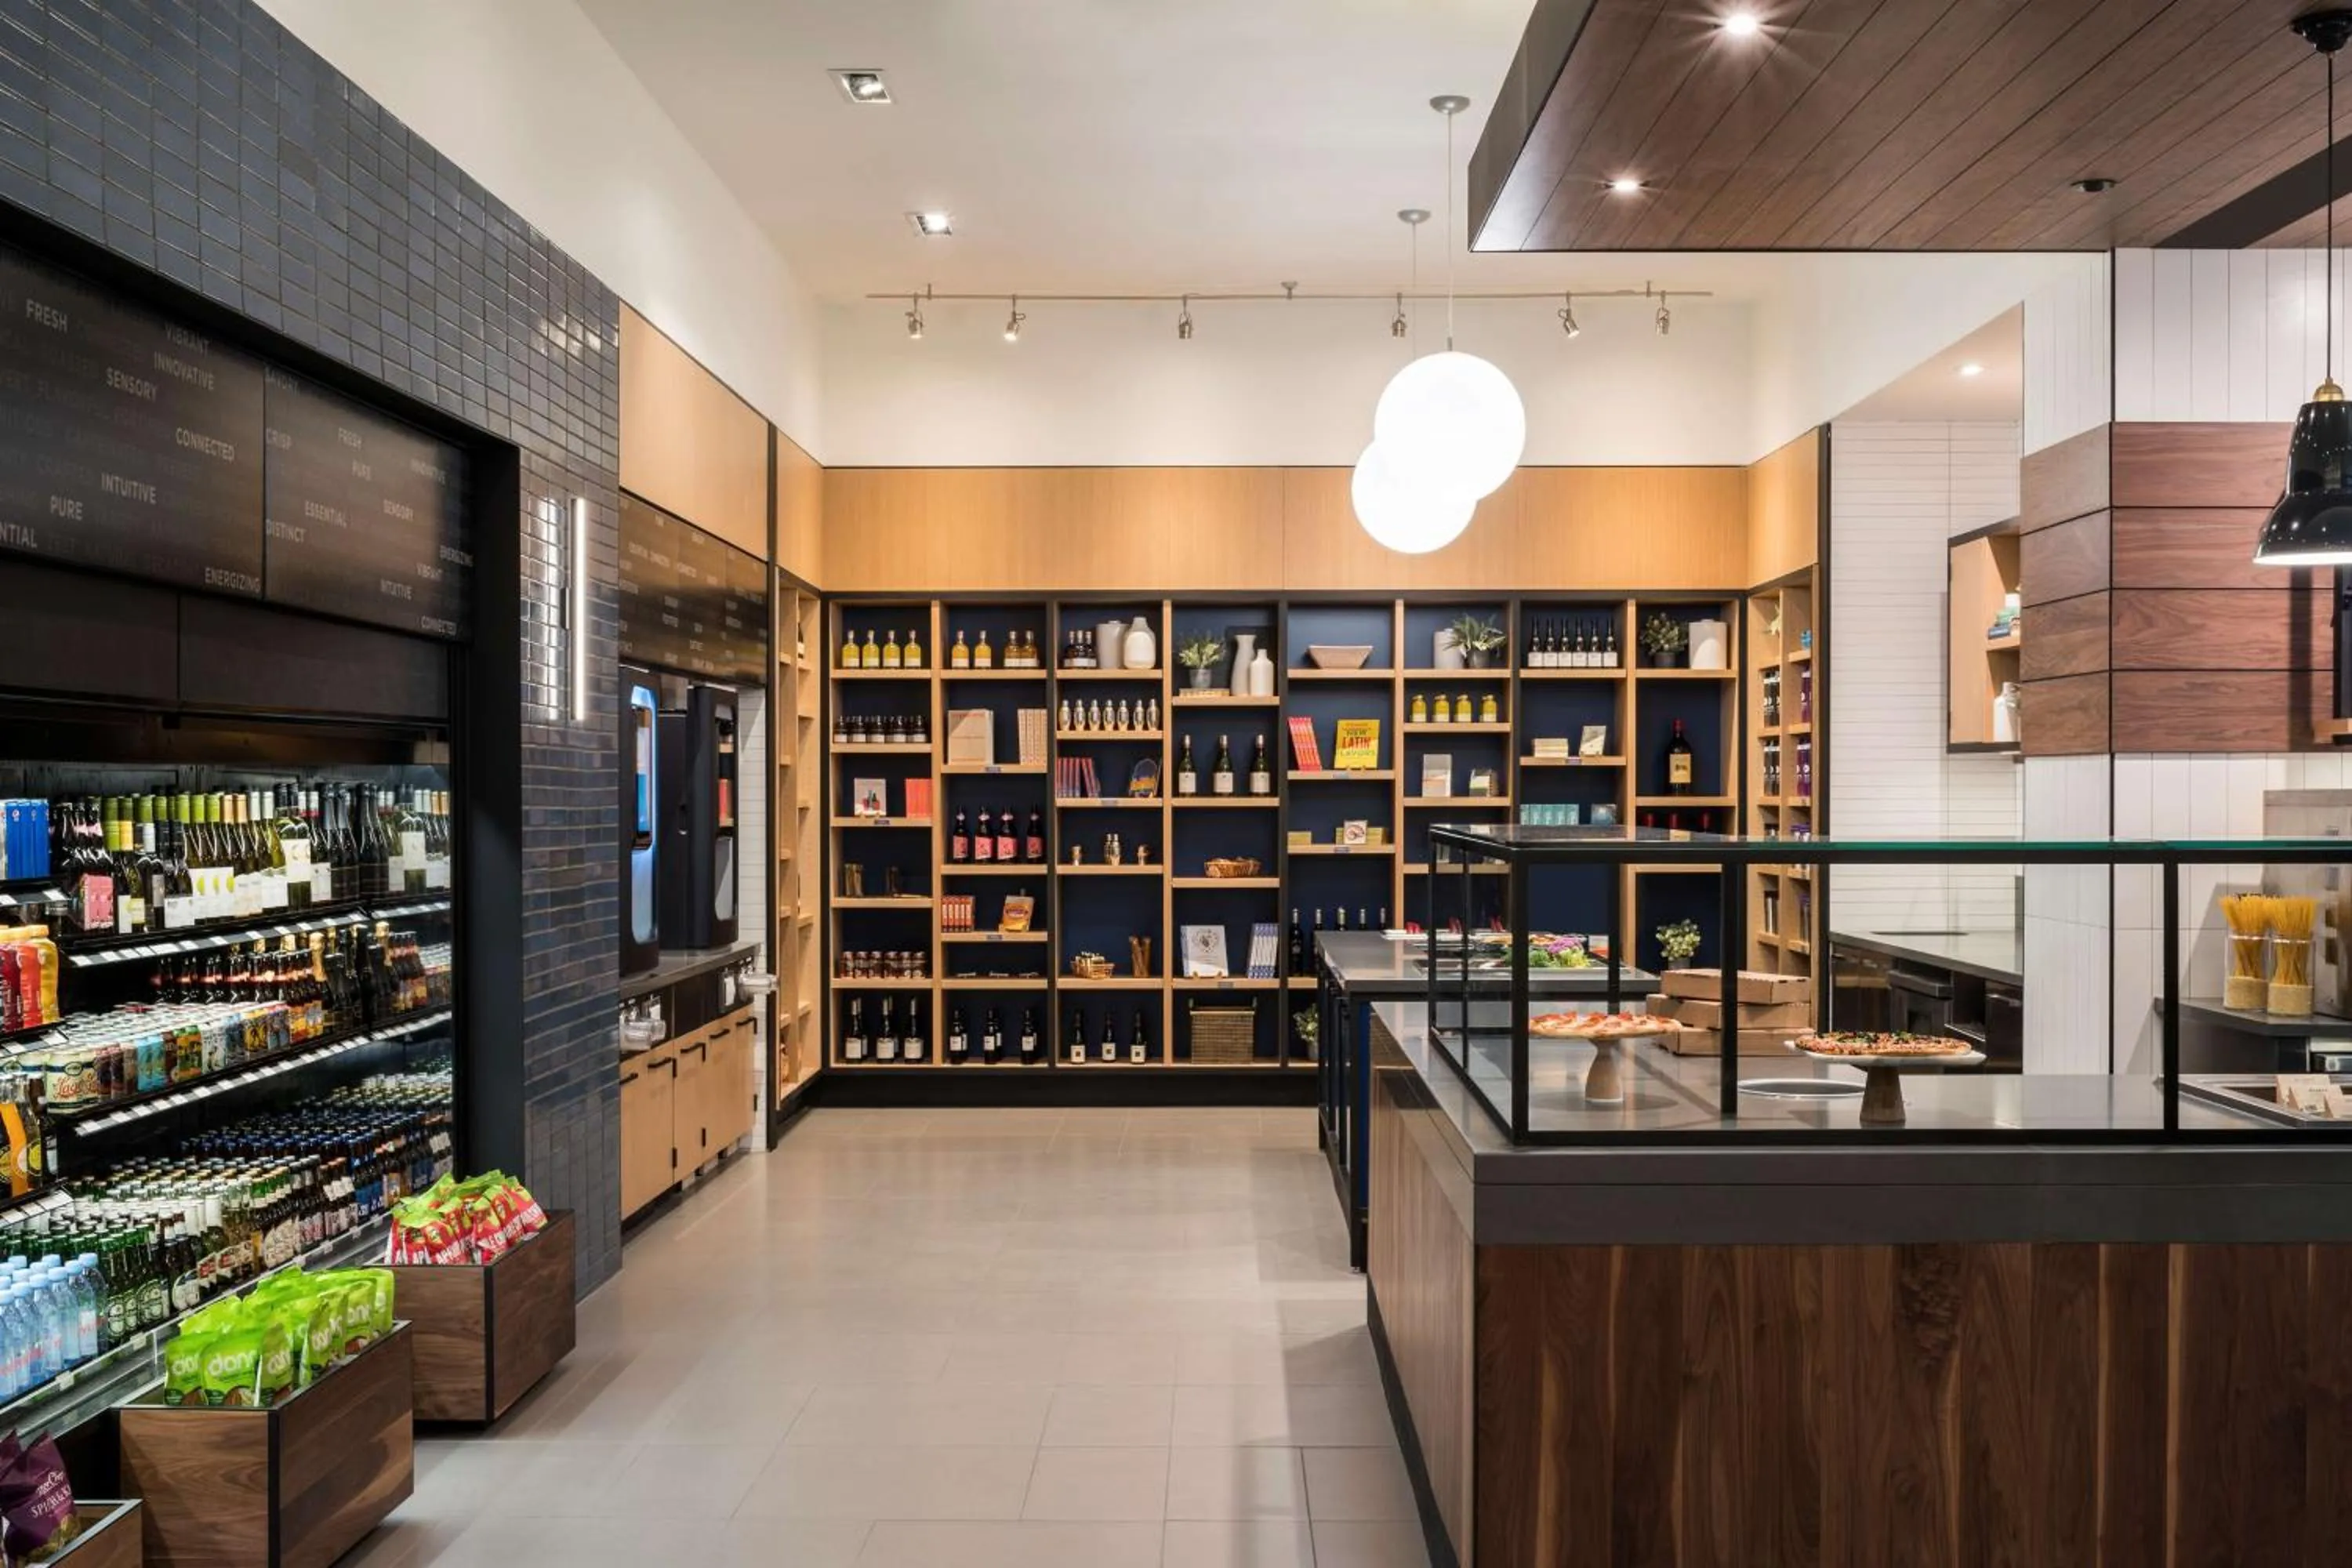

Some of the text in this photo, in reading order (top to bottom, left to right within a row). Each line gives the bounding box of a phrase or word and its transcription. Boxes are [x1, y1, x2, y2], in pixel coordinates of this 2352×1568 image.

[26, 299, 68, 334] FRESH
[165, 322, 210, 358] VIBRANT
[106, 367, 158, 403] SENSORY
[154, 351, 215, 391] INNOVATIVE
[176, 427, 235, 463] CONNECTED
[101, 473, 157, 504] INTUITIVE
[50, 495, 84, 521] PURE
[305, 499, 347, 528] ESSENTIAL
[266, 518, 306, 543] DISTINCT
[205, 567, 261, 593] ENERGIZING
